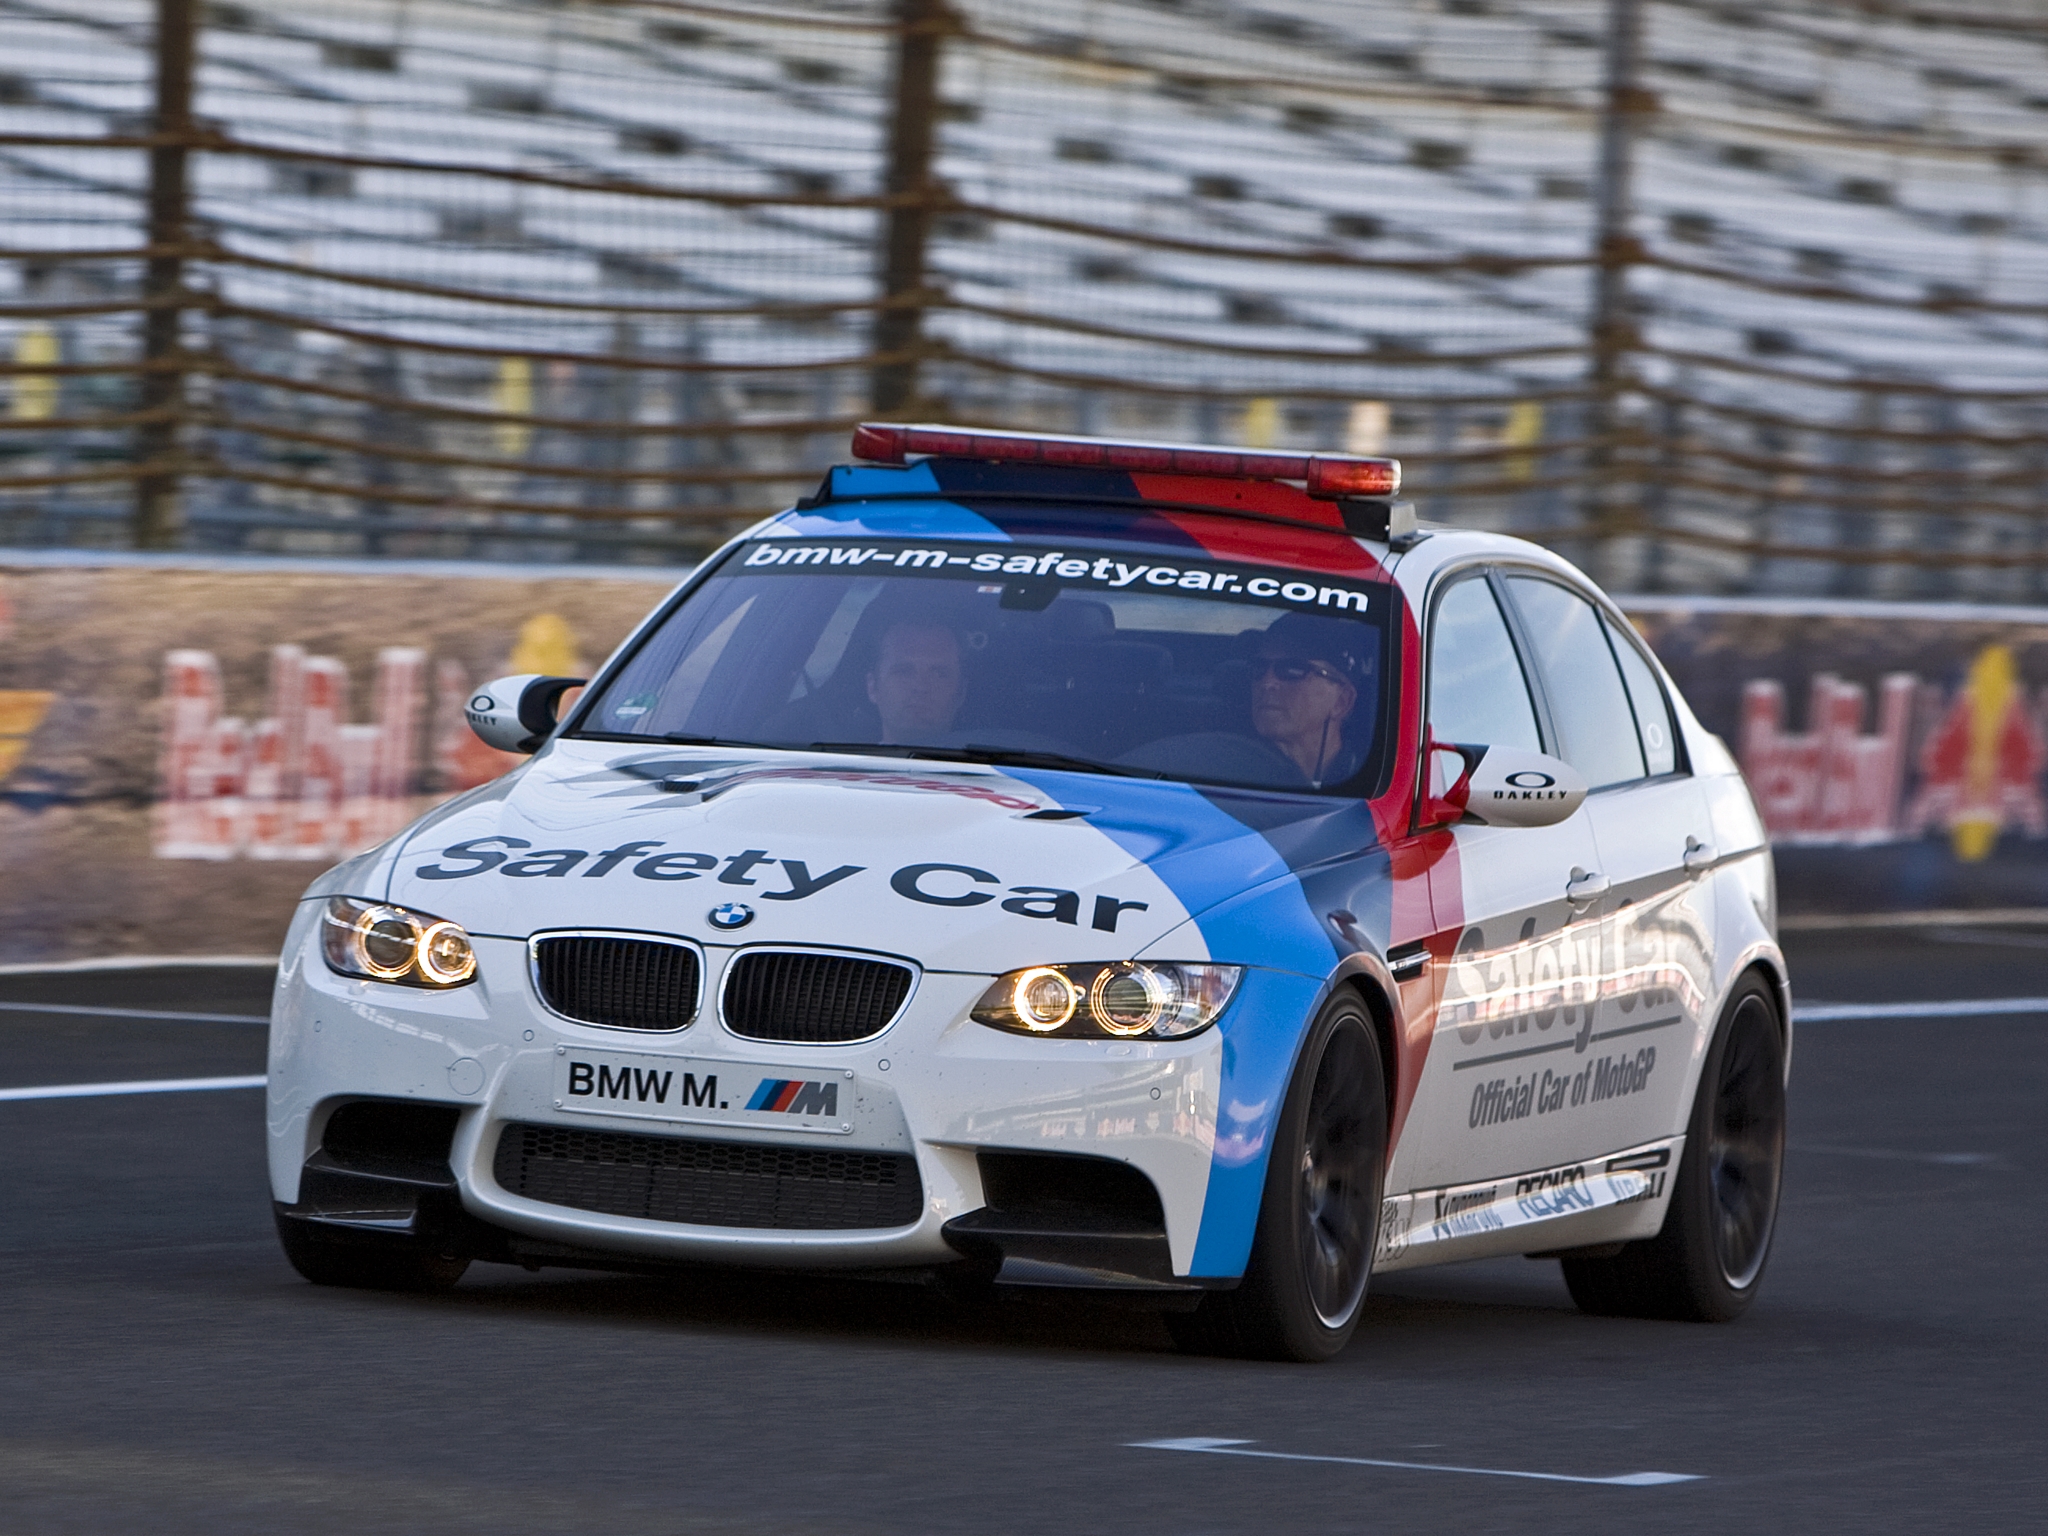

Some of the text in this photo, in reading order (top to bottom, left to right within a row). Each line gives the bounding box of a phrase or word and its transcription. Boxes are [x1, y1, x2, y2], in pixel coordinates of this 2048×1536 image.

[744, 544, 1370, 612] bmw-m-safetycar.com
[1493, 790, 1567, 800] OAKLEY
[416, 836, 1149, 934] Safety Car
[568, 1061, 673, 1104] BMW
[681, 1073, 729, 1110] M.
[1469, 1046, 1656, 1129] Official Car of MotoGP
[1515, 1164, 1596, 1219] RECARO
[1604, 1148, 1671, 1206] PIRLI
